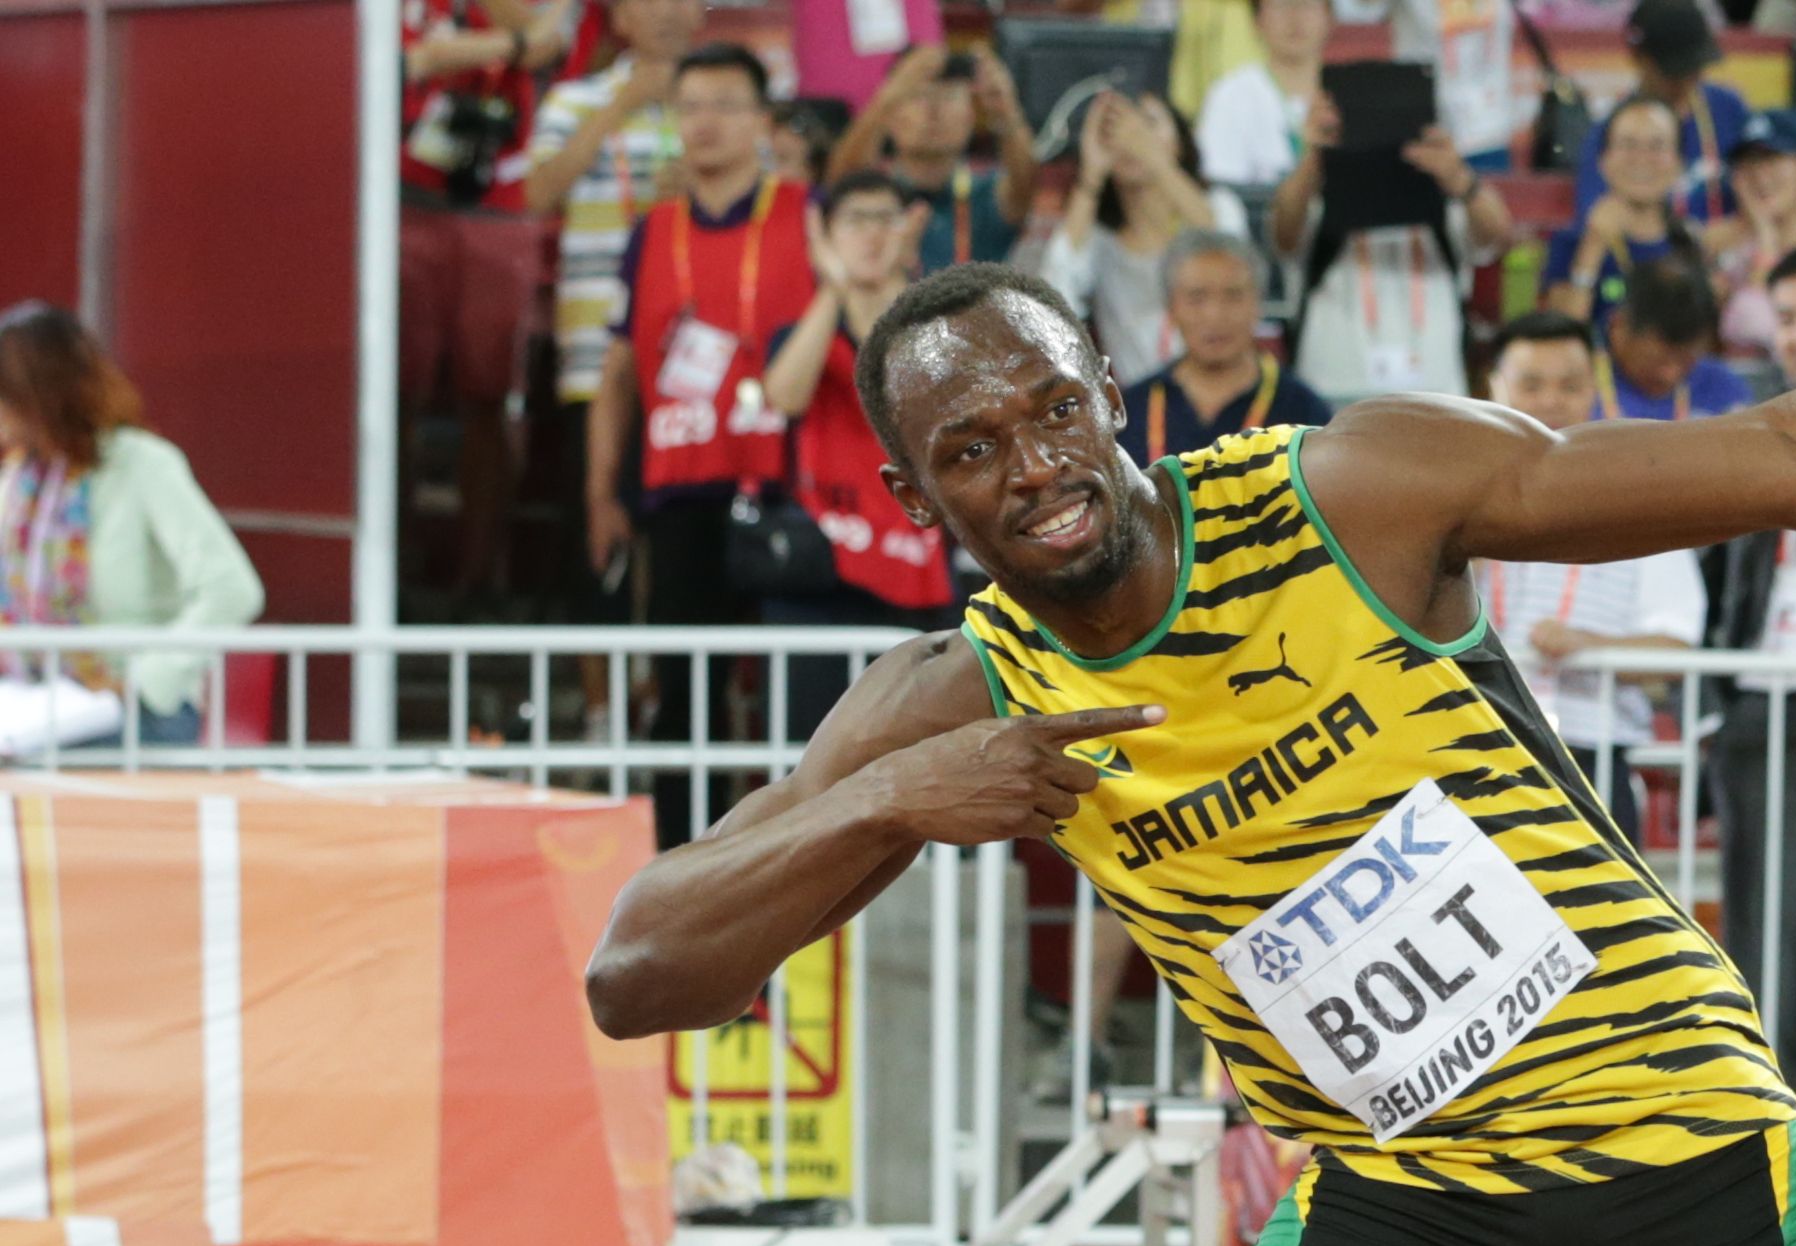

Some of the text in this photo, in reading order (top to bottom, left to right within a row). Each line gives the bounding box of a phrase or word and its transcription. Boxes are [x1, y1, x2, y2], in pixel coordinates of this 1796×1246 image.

[1111, 692, 1379, 871] JAMAICA
[1276, 805, 1452, 947] TDK
[1305, 883, 1503, 1075] BOLT
[1369, 941, 1573, 1132] BEIJING 2015
